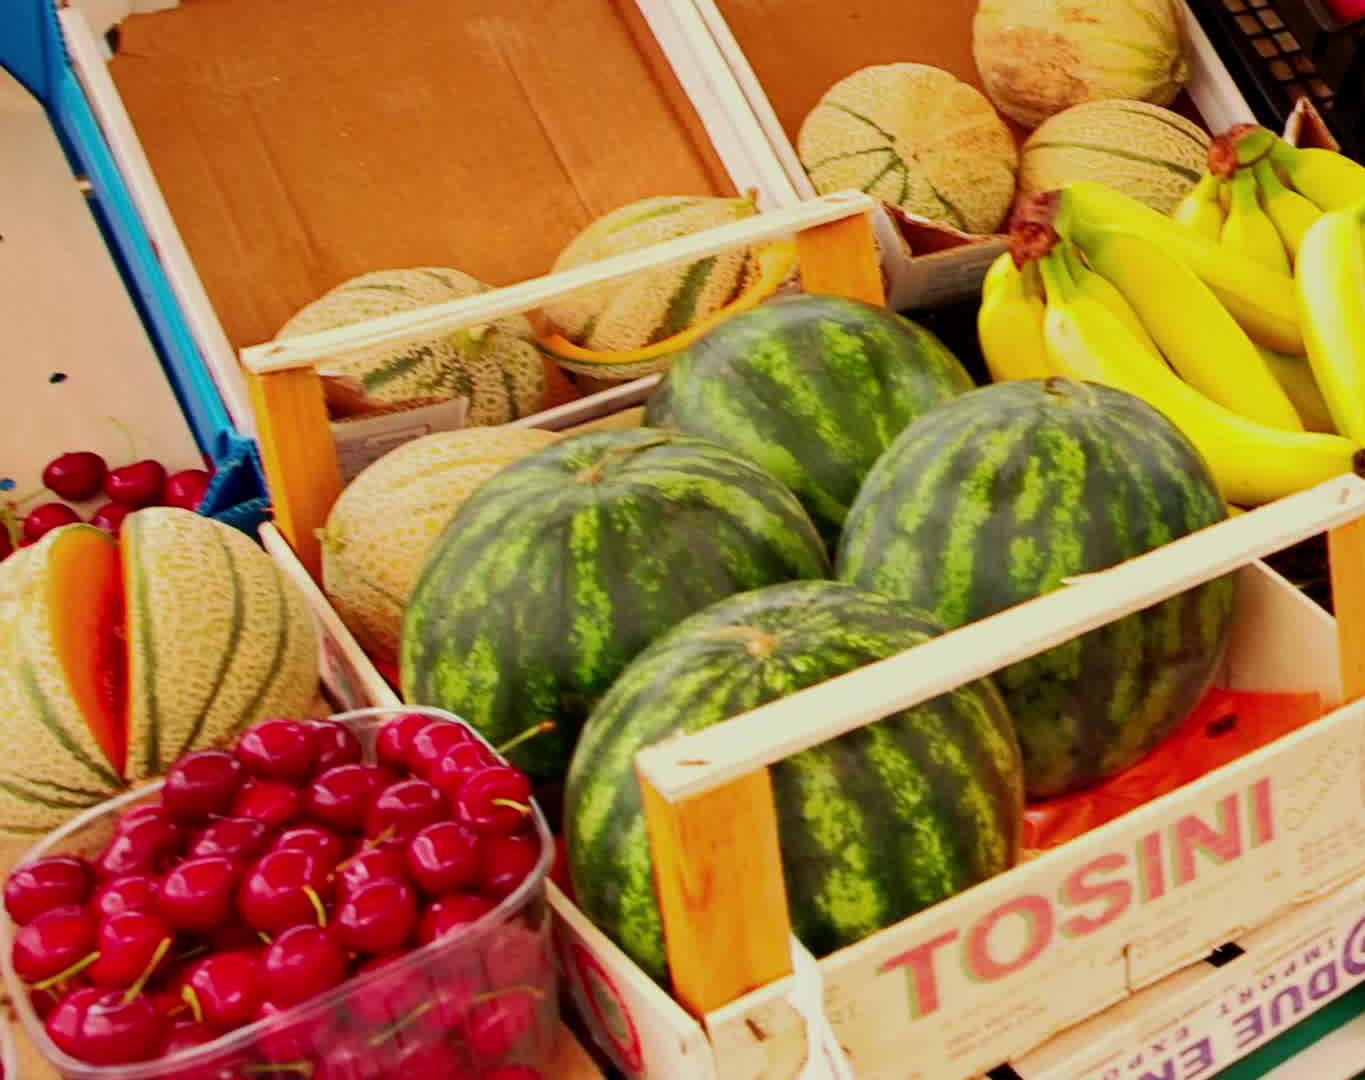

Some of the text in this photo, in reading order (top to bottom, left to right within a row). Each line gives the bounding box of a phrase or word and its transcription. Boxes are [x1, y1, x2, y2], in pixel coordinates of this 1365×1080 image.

[876, 777, 1276, 1021] TOSINI
[1219, 935, 1337, 1017] IMPORT
[1231, 958, 1340, 1050] DUE
